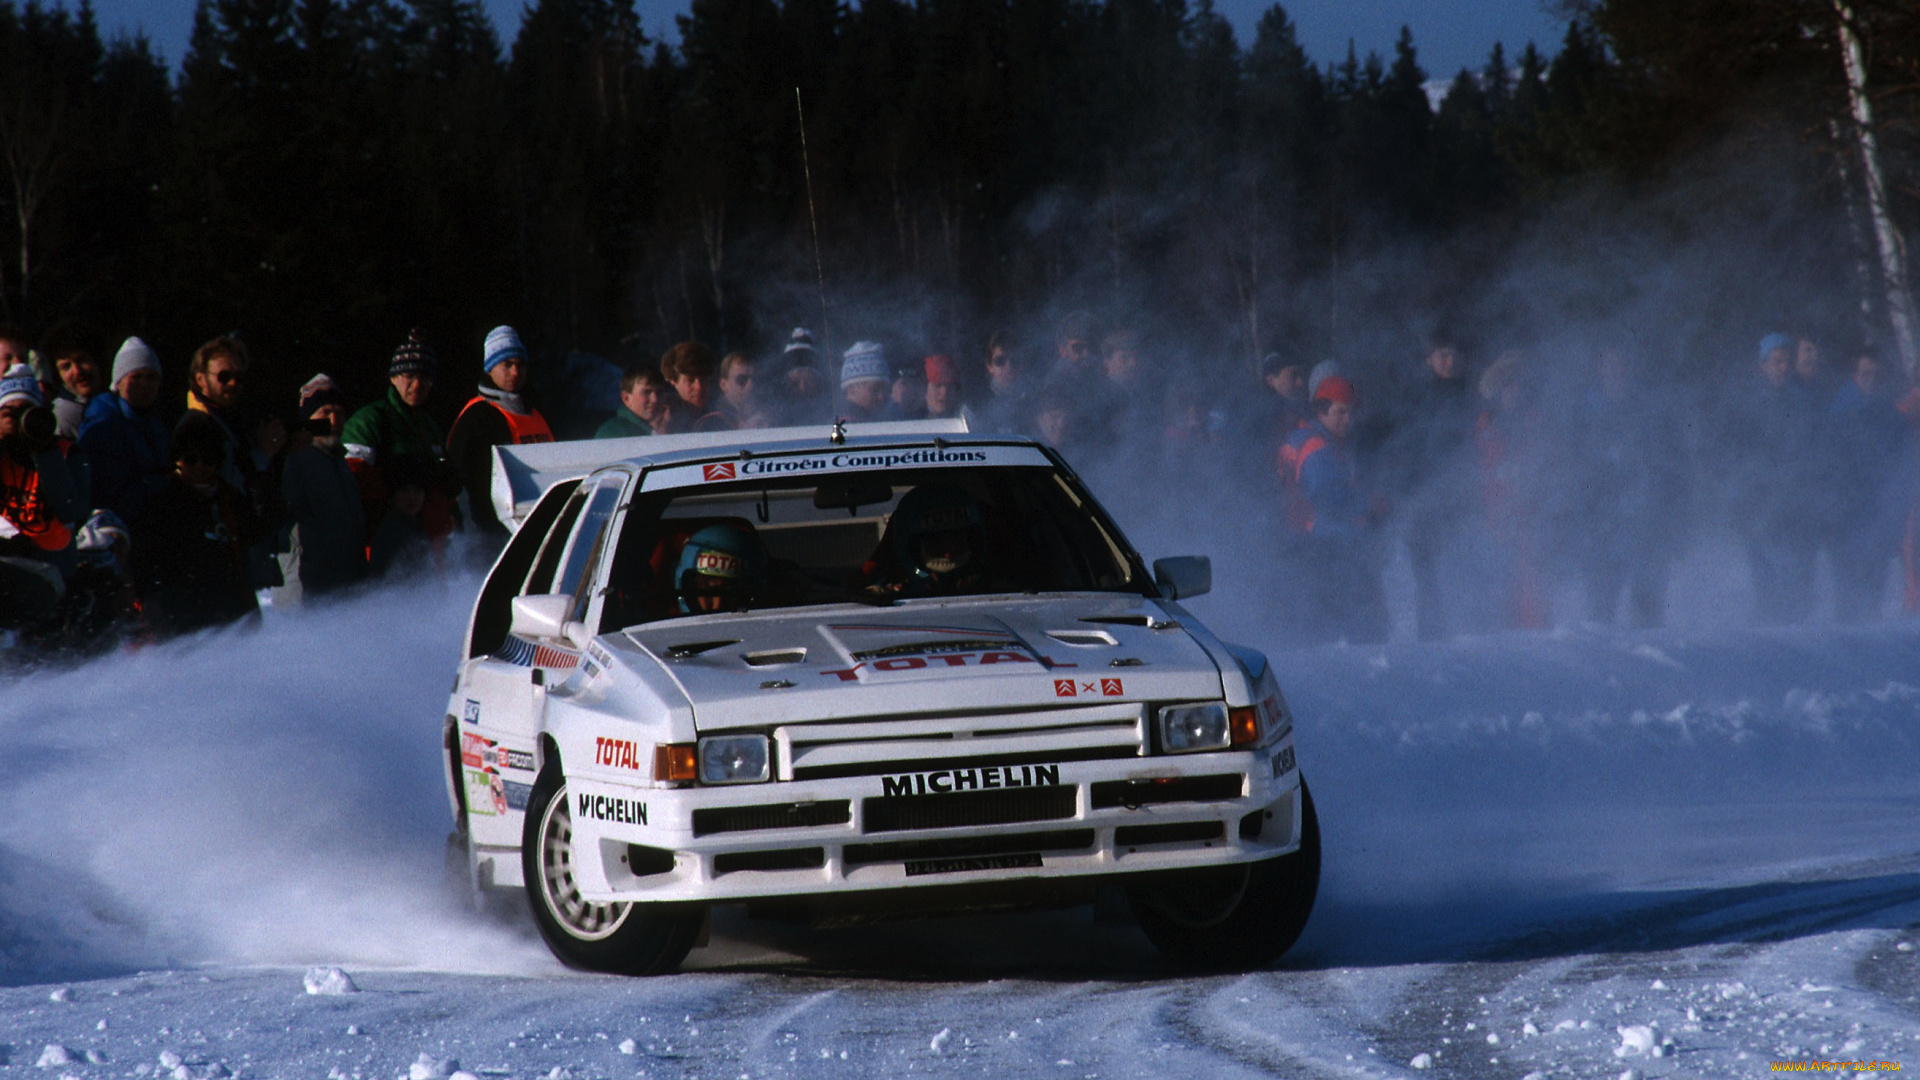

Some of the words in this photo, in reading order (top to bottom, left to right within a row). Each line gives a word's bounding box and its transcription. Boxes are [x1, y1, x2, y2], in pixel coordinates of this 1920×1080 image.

[741, 457, 827, 476] Citroën
[831, 449, 987, 468] Compétitions
[819, 651, 1079, 682] TOTAL
[595, 736, 640, 770] TOTAL
[882, 763, 1059, 798] MICHELIN
[578, 793, 649, 826] MICHELIN
